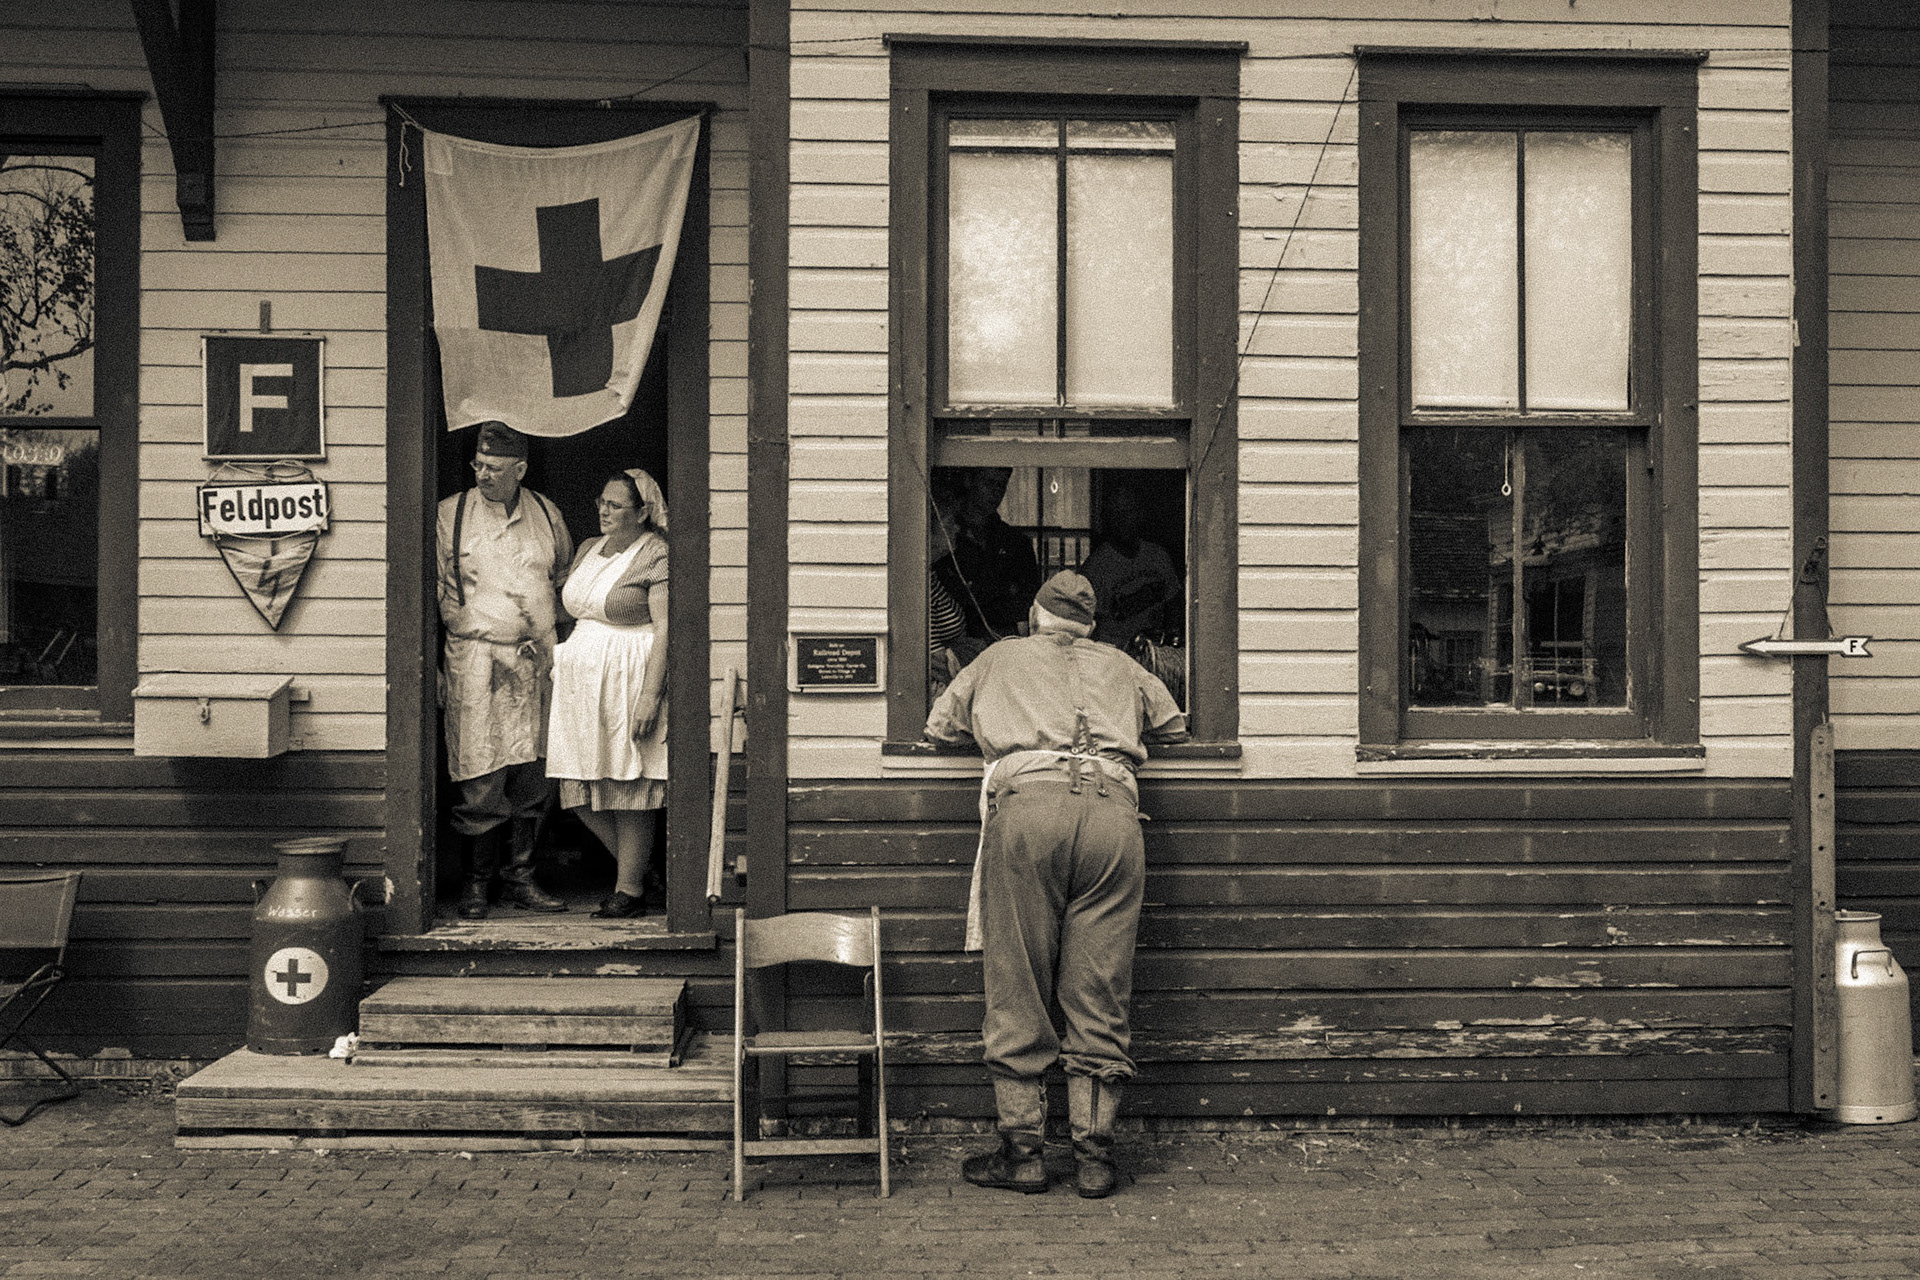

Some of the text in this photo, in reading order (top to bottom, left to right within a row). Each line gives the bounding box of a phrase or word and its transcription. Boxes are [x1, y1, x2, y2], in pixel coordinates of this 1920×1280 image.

[239, 363, 294, 432] F
[202, 488, 325, 530] Feldpost
[1850, 640, 1858, 653] F
[267, 904, 318, 918] Wasser
